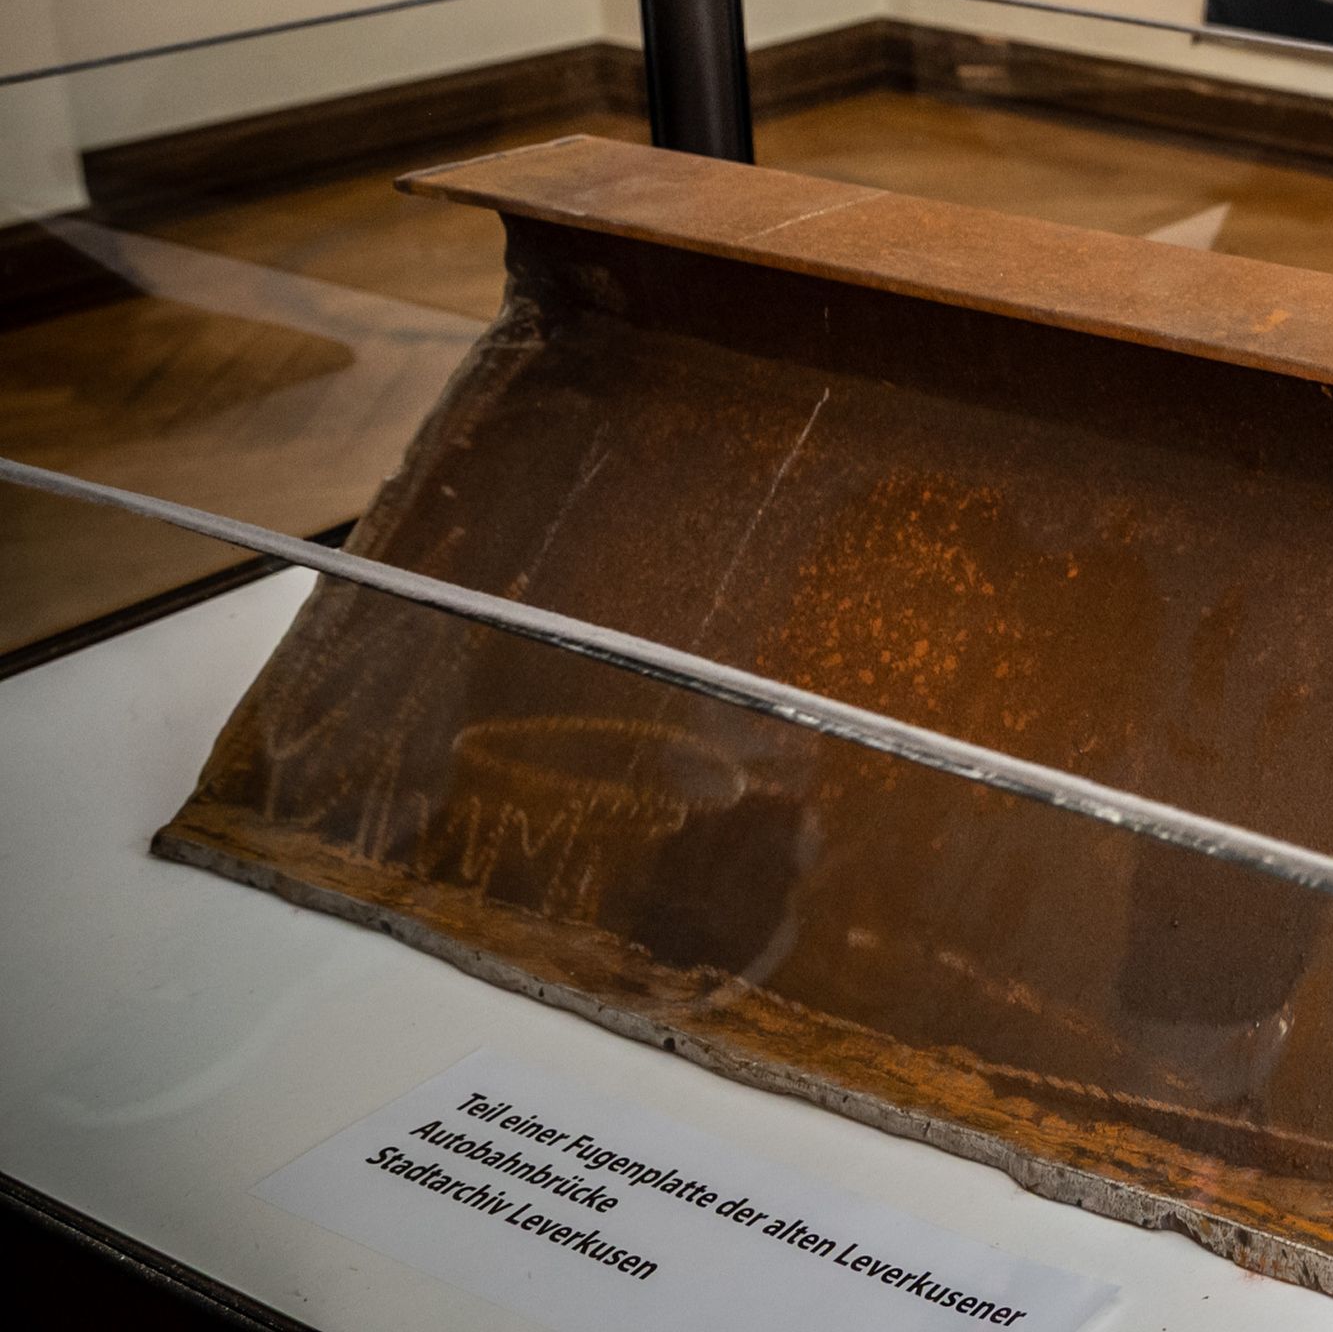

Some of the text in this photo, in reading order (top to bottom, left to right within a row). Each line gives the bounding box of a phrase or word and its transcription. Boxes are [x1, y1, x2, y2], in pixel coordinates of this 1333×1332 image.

[365, 1146, 658, 1280] Stadtarchiv Leverkusen
[408, 1120, 619, 1213] Autobahnbrücke
[456, 1092, 1027, 1327] Teil einer Fugenplatte der alten Leverkusener
